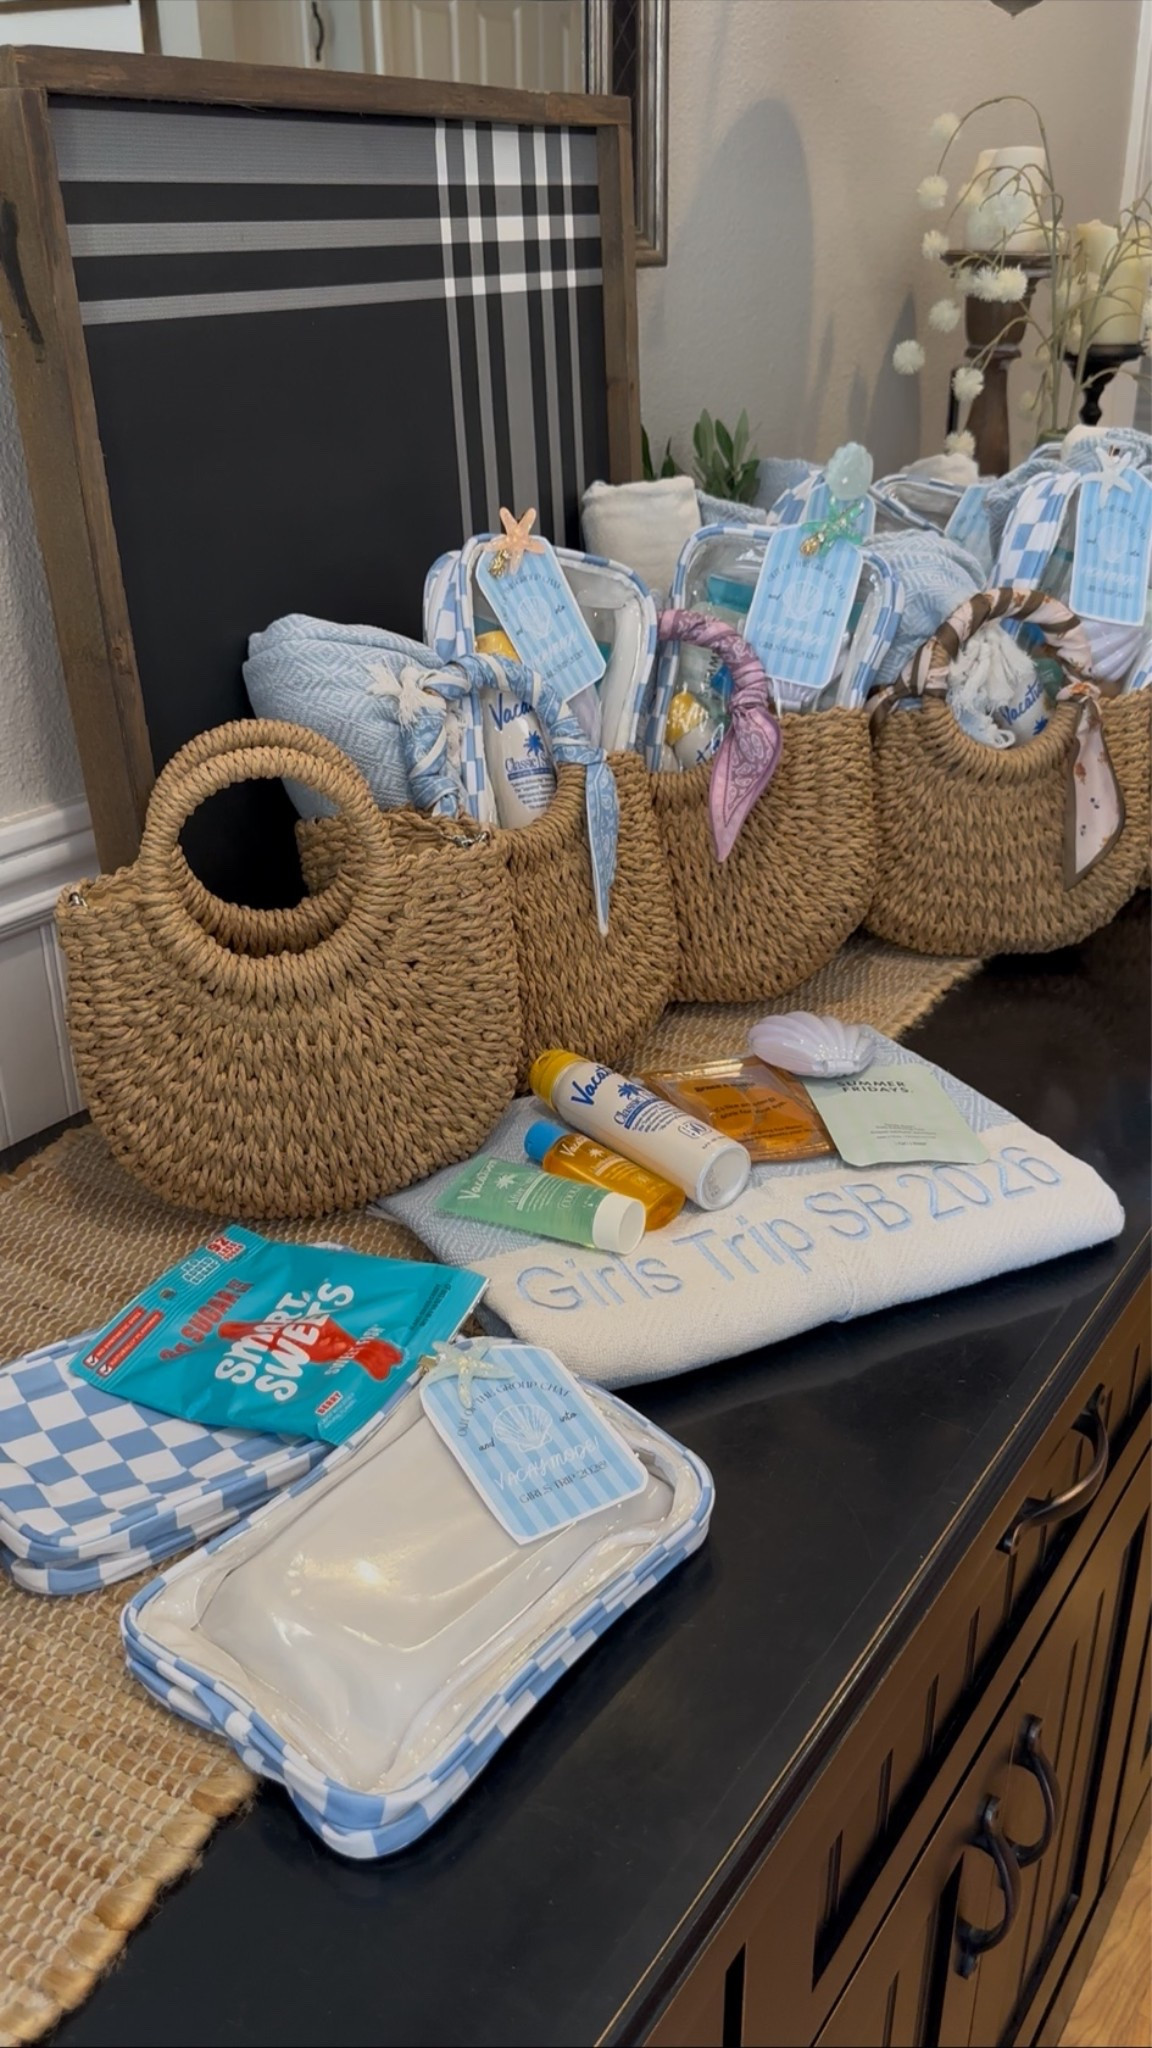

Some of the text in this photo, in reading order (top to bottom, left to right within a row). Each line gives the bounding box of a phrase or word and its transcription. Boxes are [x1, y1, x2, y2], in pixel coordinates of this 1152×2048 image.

[516, 1254, 683, 1312] Girls
[673, 1214, 814, 1282] Trip
[804, 1182, 912, 1242] SB
[897, 1146, 1064, 1222] 2026
[215, 1291, 306, 1385] SMART
[496, 1380, 537, 1393] GROUP
[540, 1382, 571, 1397] CHAT
[316, 1391, 342, 1414] BERRY
[559, 1410, 578, 1422] into
[478, 1436, 496, 1451] and
[518, 1484, 553, 1503] GIRLS
[554, 1473, 577, 1489] TRIP
